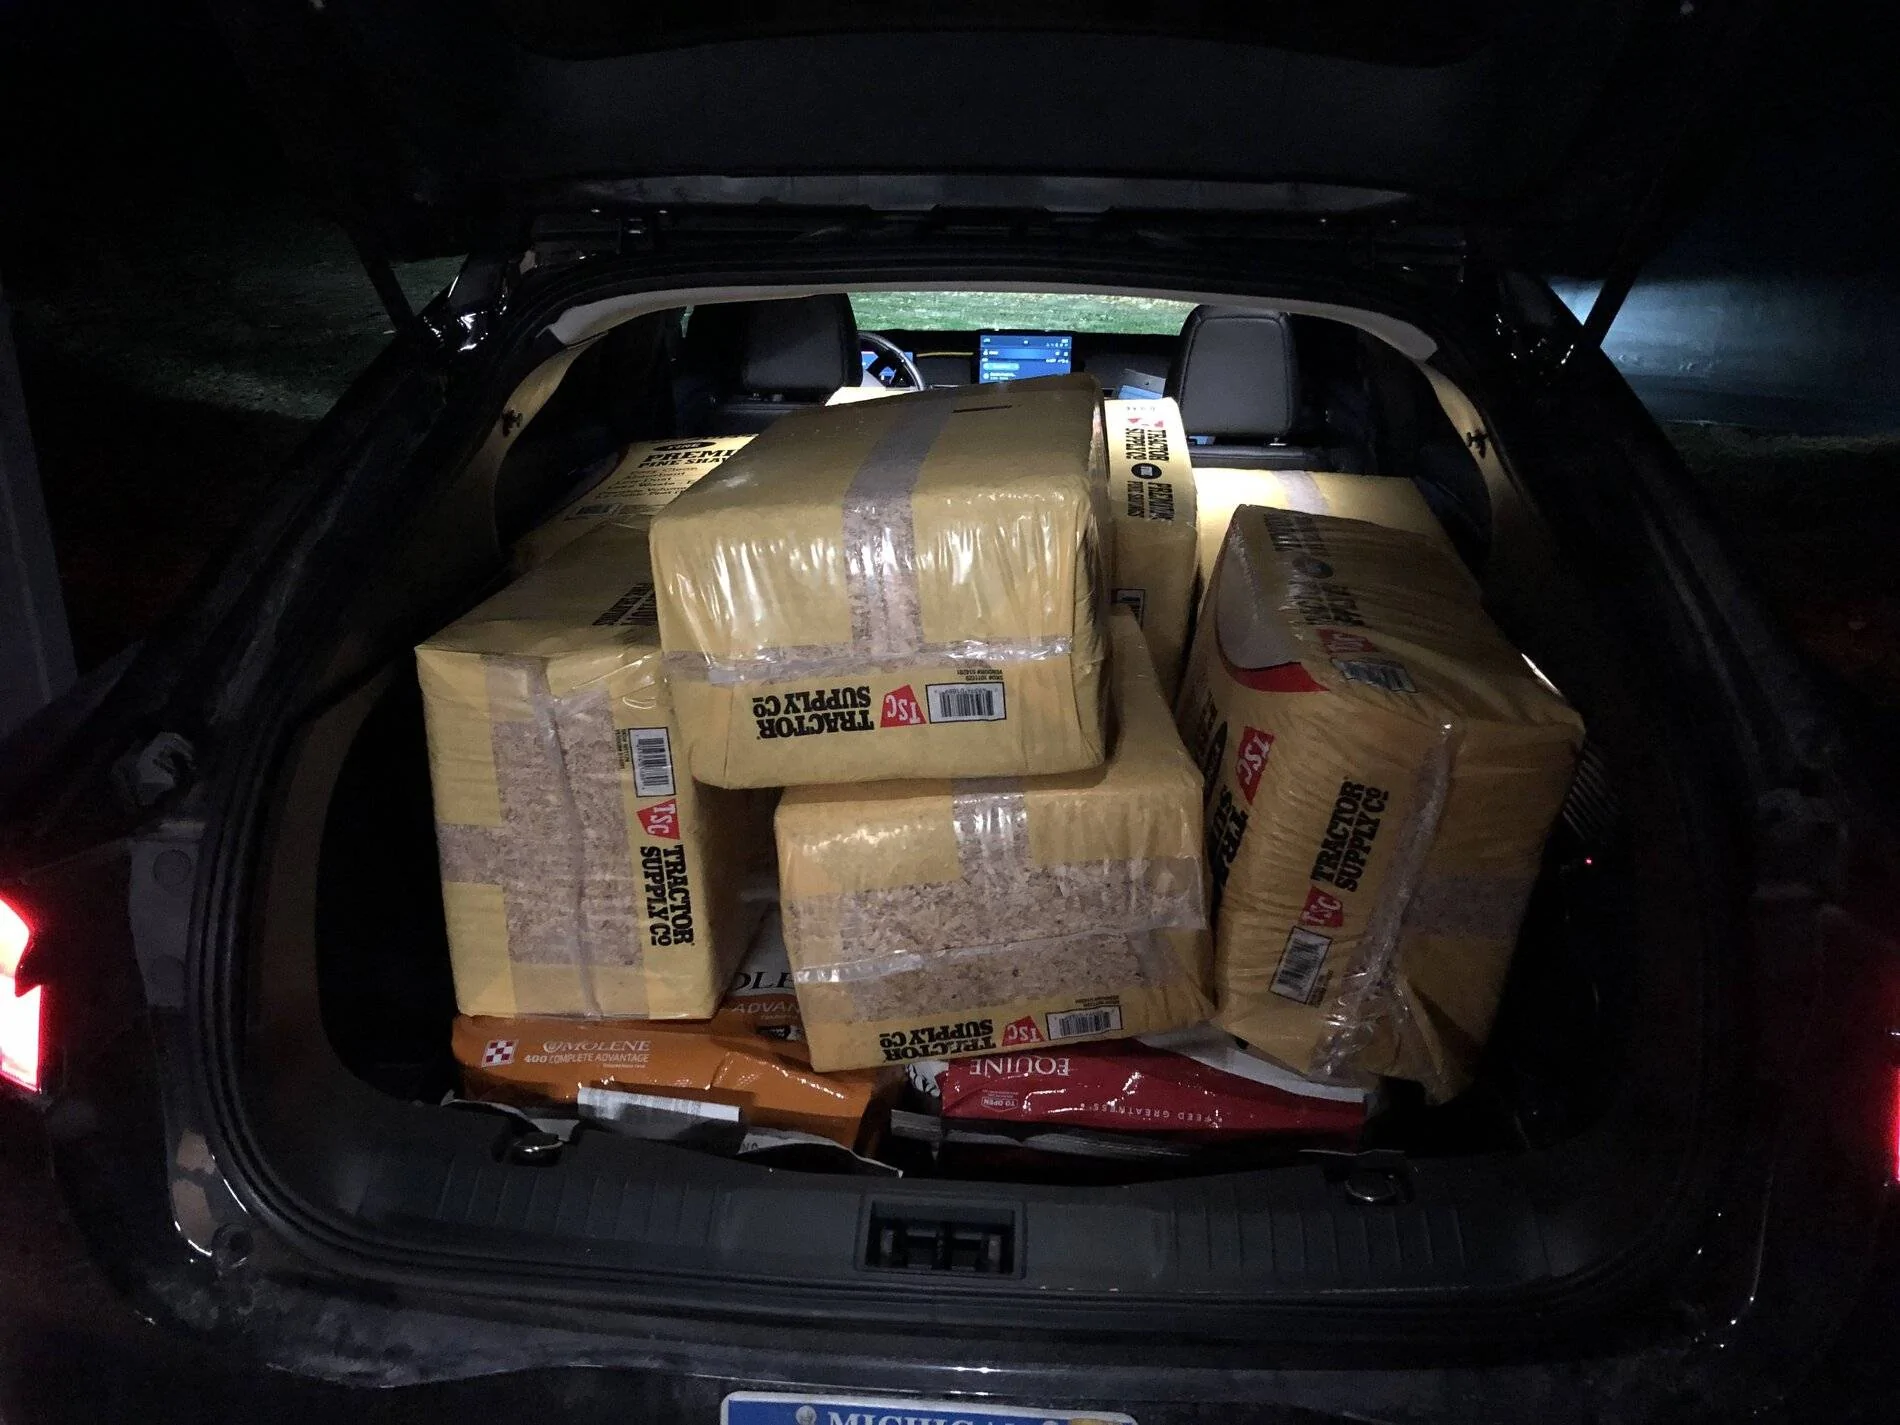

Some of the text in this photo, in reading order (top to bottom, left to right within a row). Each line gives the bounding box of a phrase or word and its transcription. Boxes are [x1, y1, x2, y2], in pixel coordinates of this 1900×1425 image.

[1148, 430, 1170, 461] TRACTOR
[784, 686, 870, 714] SUPPLY
[887, 695, 921, 724] TSC
[757, 708, 874, 738] TRACTOR
[1237, 734, 1270, 785] TSC
[647, 803, 676, 835] TSC
[1310, 780, 1367, 882] TRACTOR
[1334, 816, 1382, 893] SUPPLY
[640, 846, 670, 921] SUPPLY
[664, 844, 694, 945] TRACTOR
[1303, 895, 1342, 926] TSC
[909, 1019, 993, 1047] SUPPLY
[1008, 1023, 1042, 1042] TSC
[524, 1053, 650, 1064] 400 COMPLETE ADVANTAGE
[884, 1035, 997, 1062] TRACTOR
[970, 1057, 1069, 1077] EQUINE
[983, 1099, 1004, 1107] OPEN
